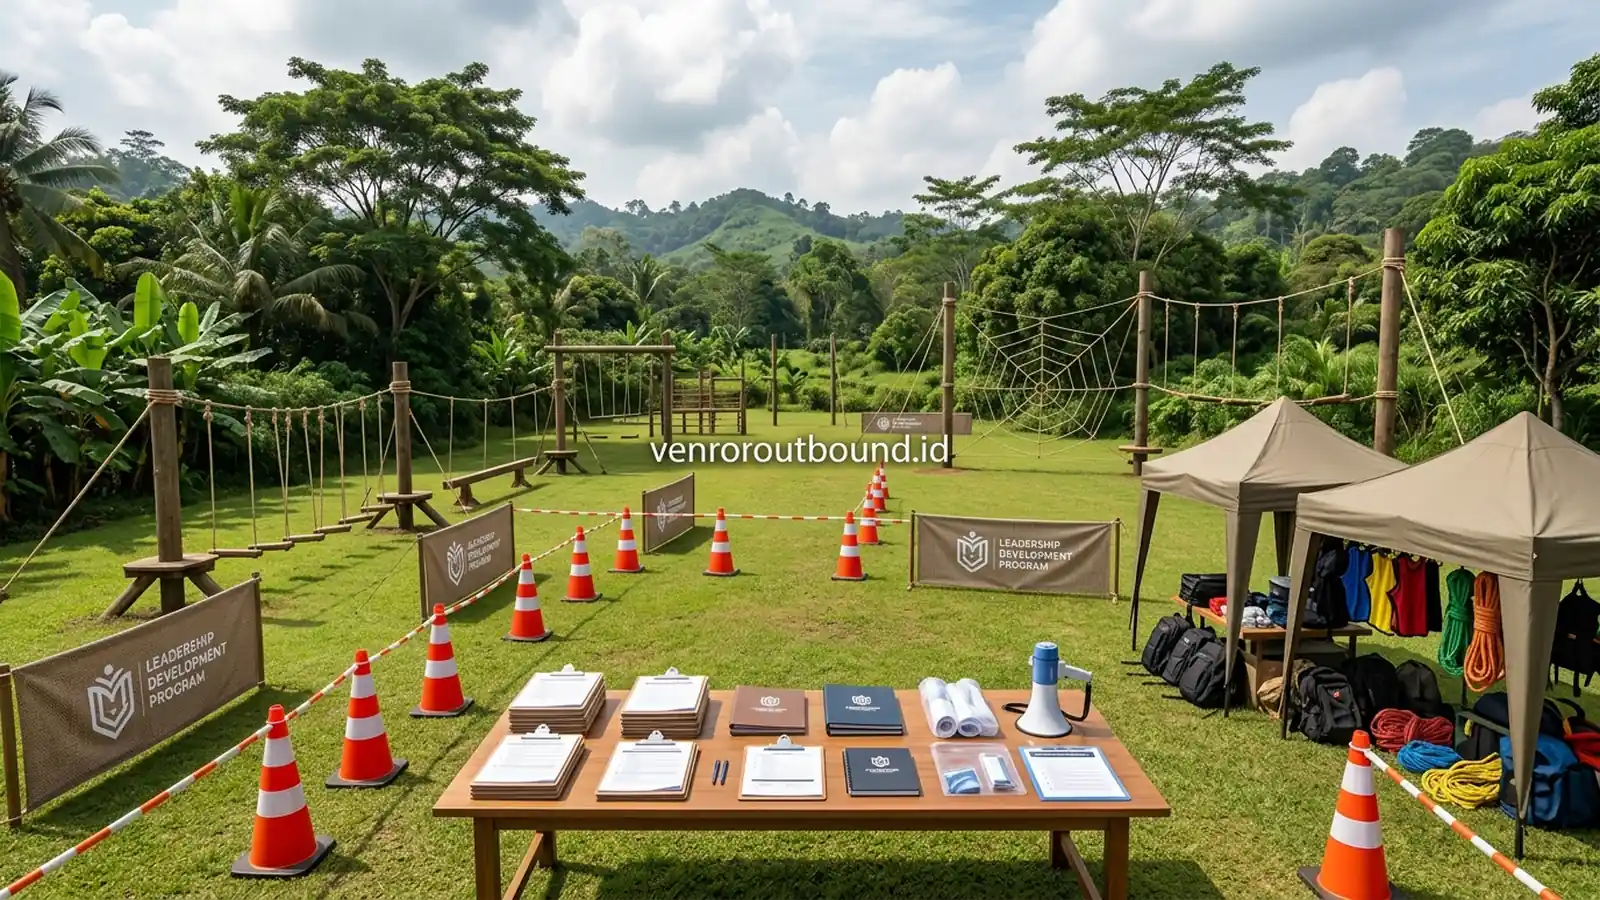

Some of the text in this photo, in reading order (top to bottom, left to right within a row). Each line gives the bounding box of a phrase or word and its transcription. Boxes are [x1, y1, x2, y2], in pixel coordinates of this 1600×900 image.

[999, 538, 1061, 549] LEADERSHIP
[999, 549, 1073, 561] DEVELOPMENT
[999, 560, 1049, 571] PROGRAM
[147, 641, 228, 691] DEVELOPMENT
[149, 669, 206, 708] PROGRAM
